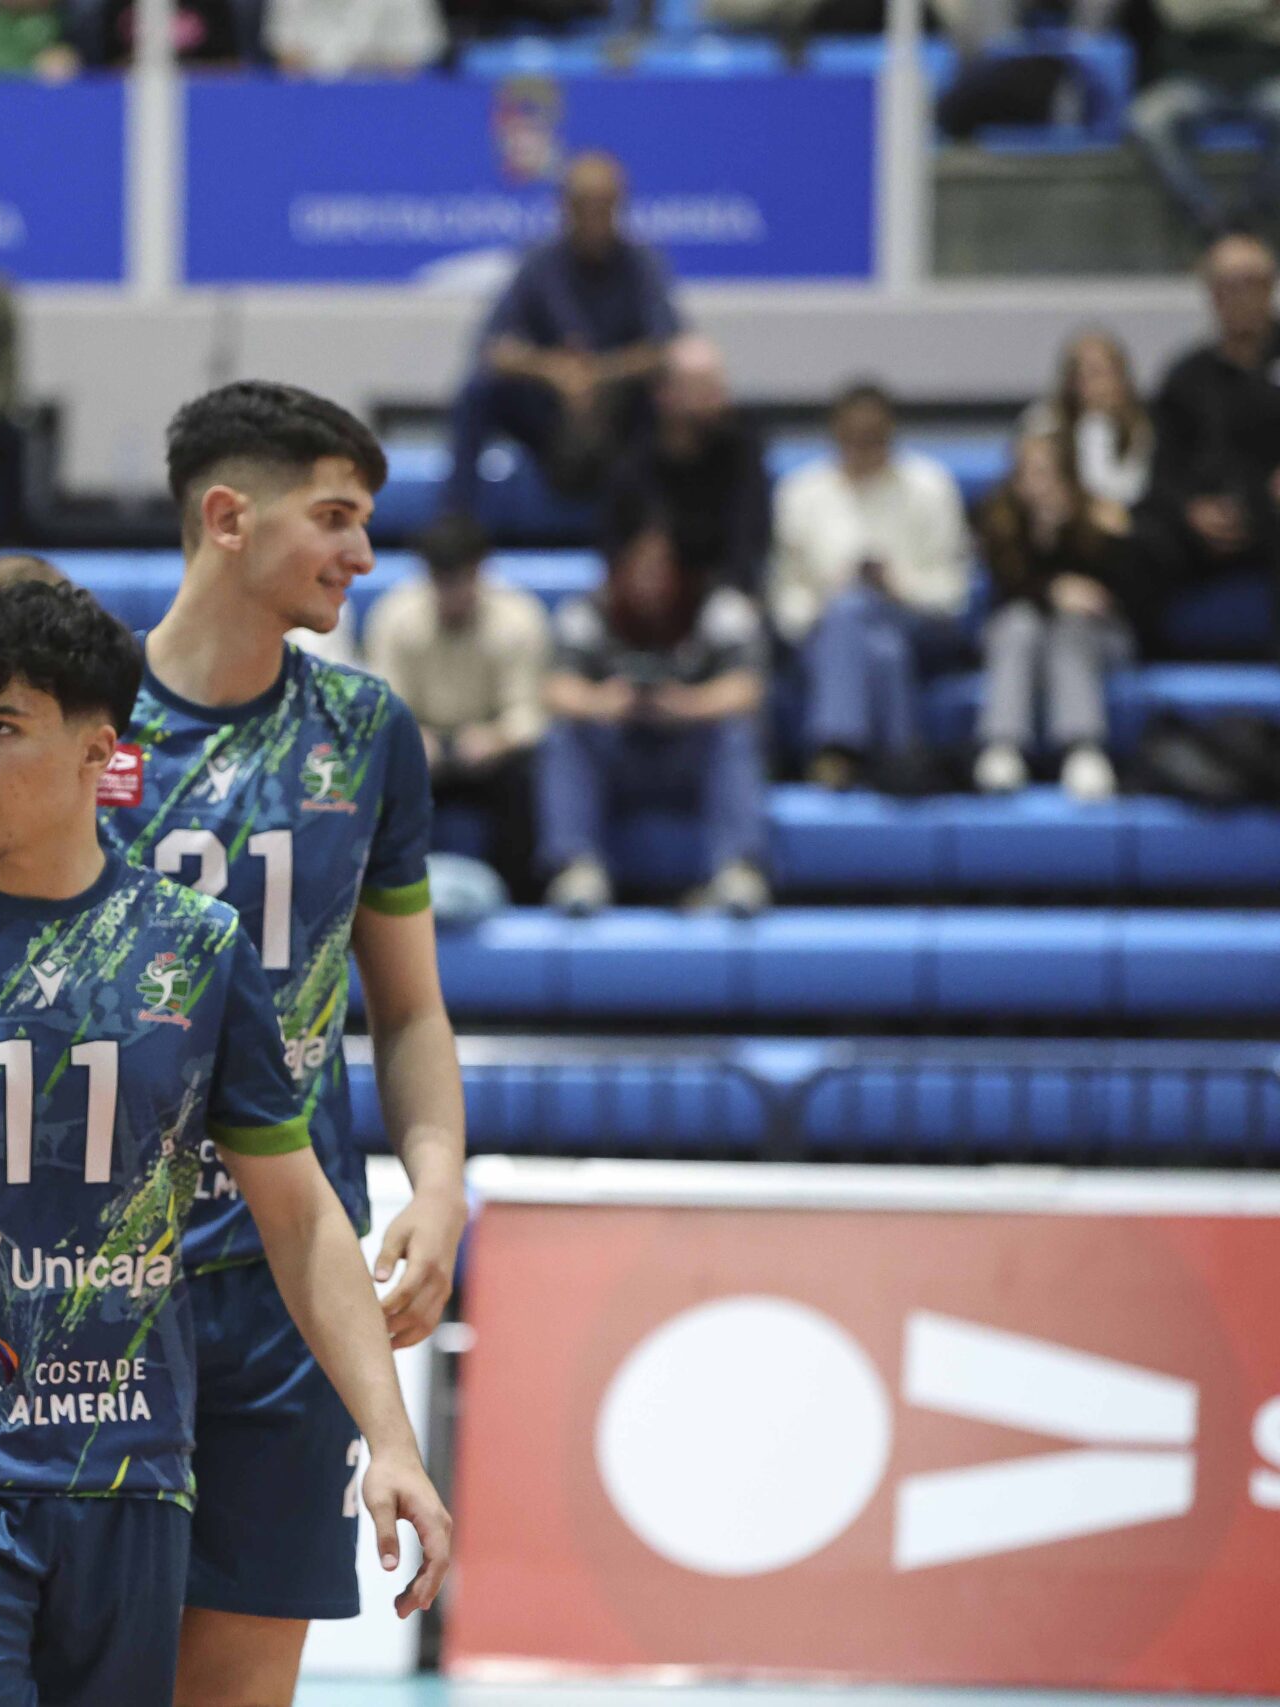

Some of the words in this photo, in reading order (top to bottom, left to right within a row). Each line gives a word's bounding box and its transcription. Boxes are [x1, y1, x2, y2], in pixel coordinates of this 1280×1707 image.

[11, 1245, 173, 1298] Unicaja
[35, 1359, 111, 1384] COSTA
[115, 1357, 147, 1381] DE
[7, 1383, 152, 1425] ALMERÍA
